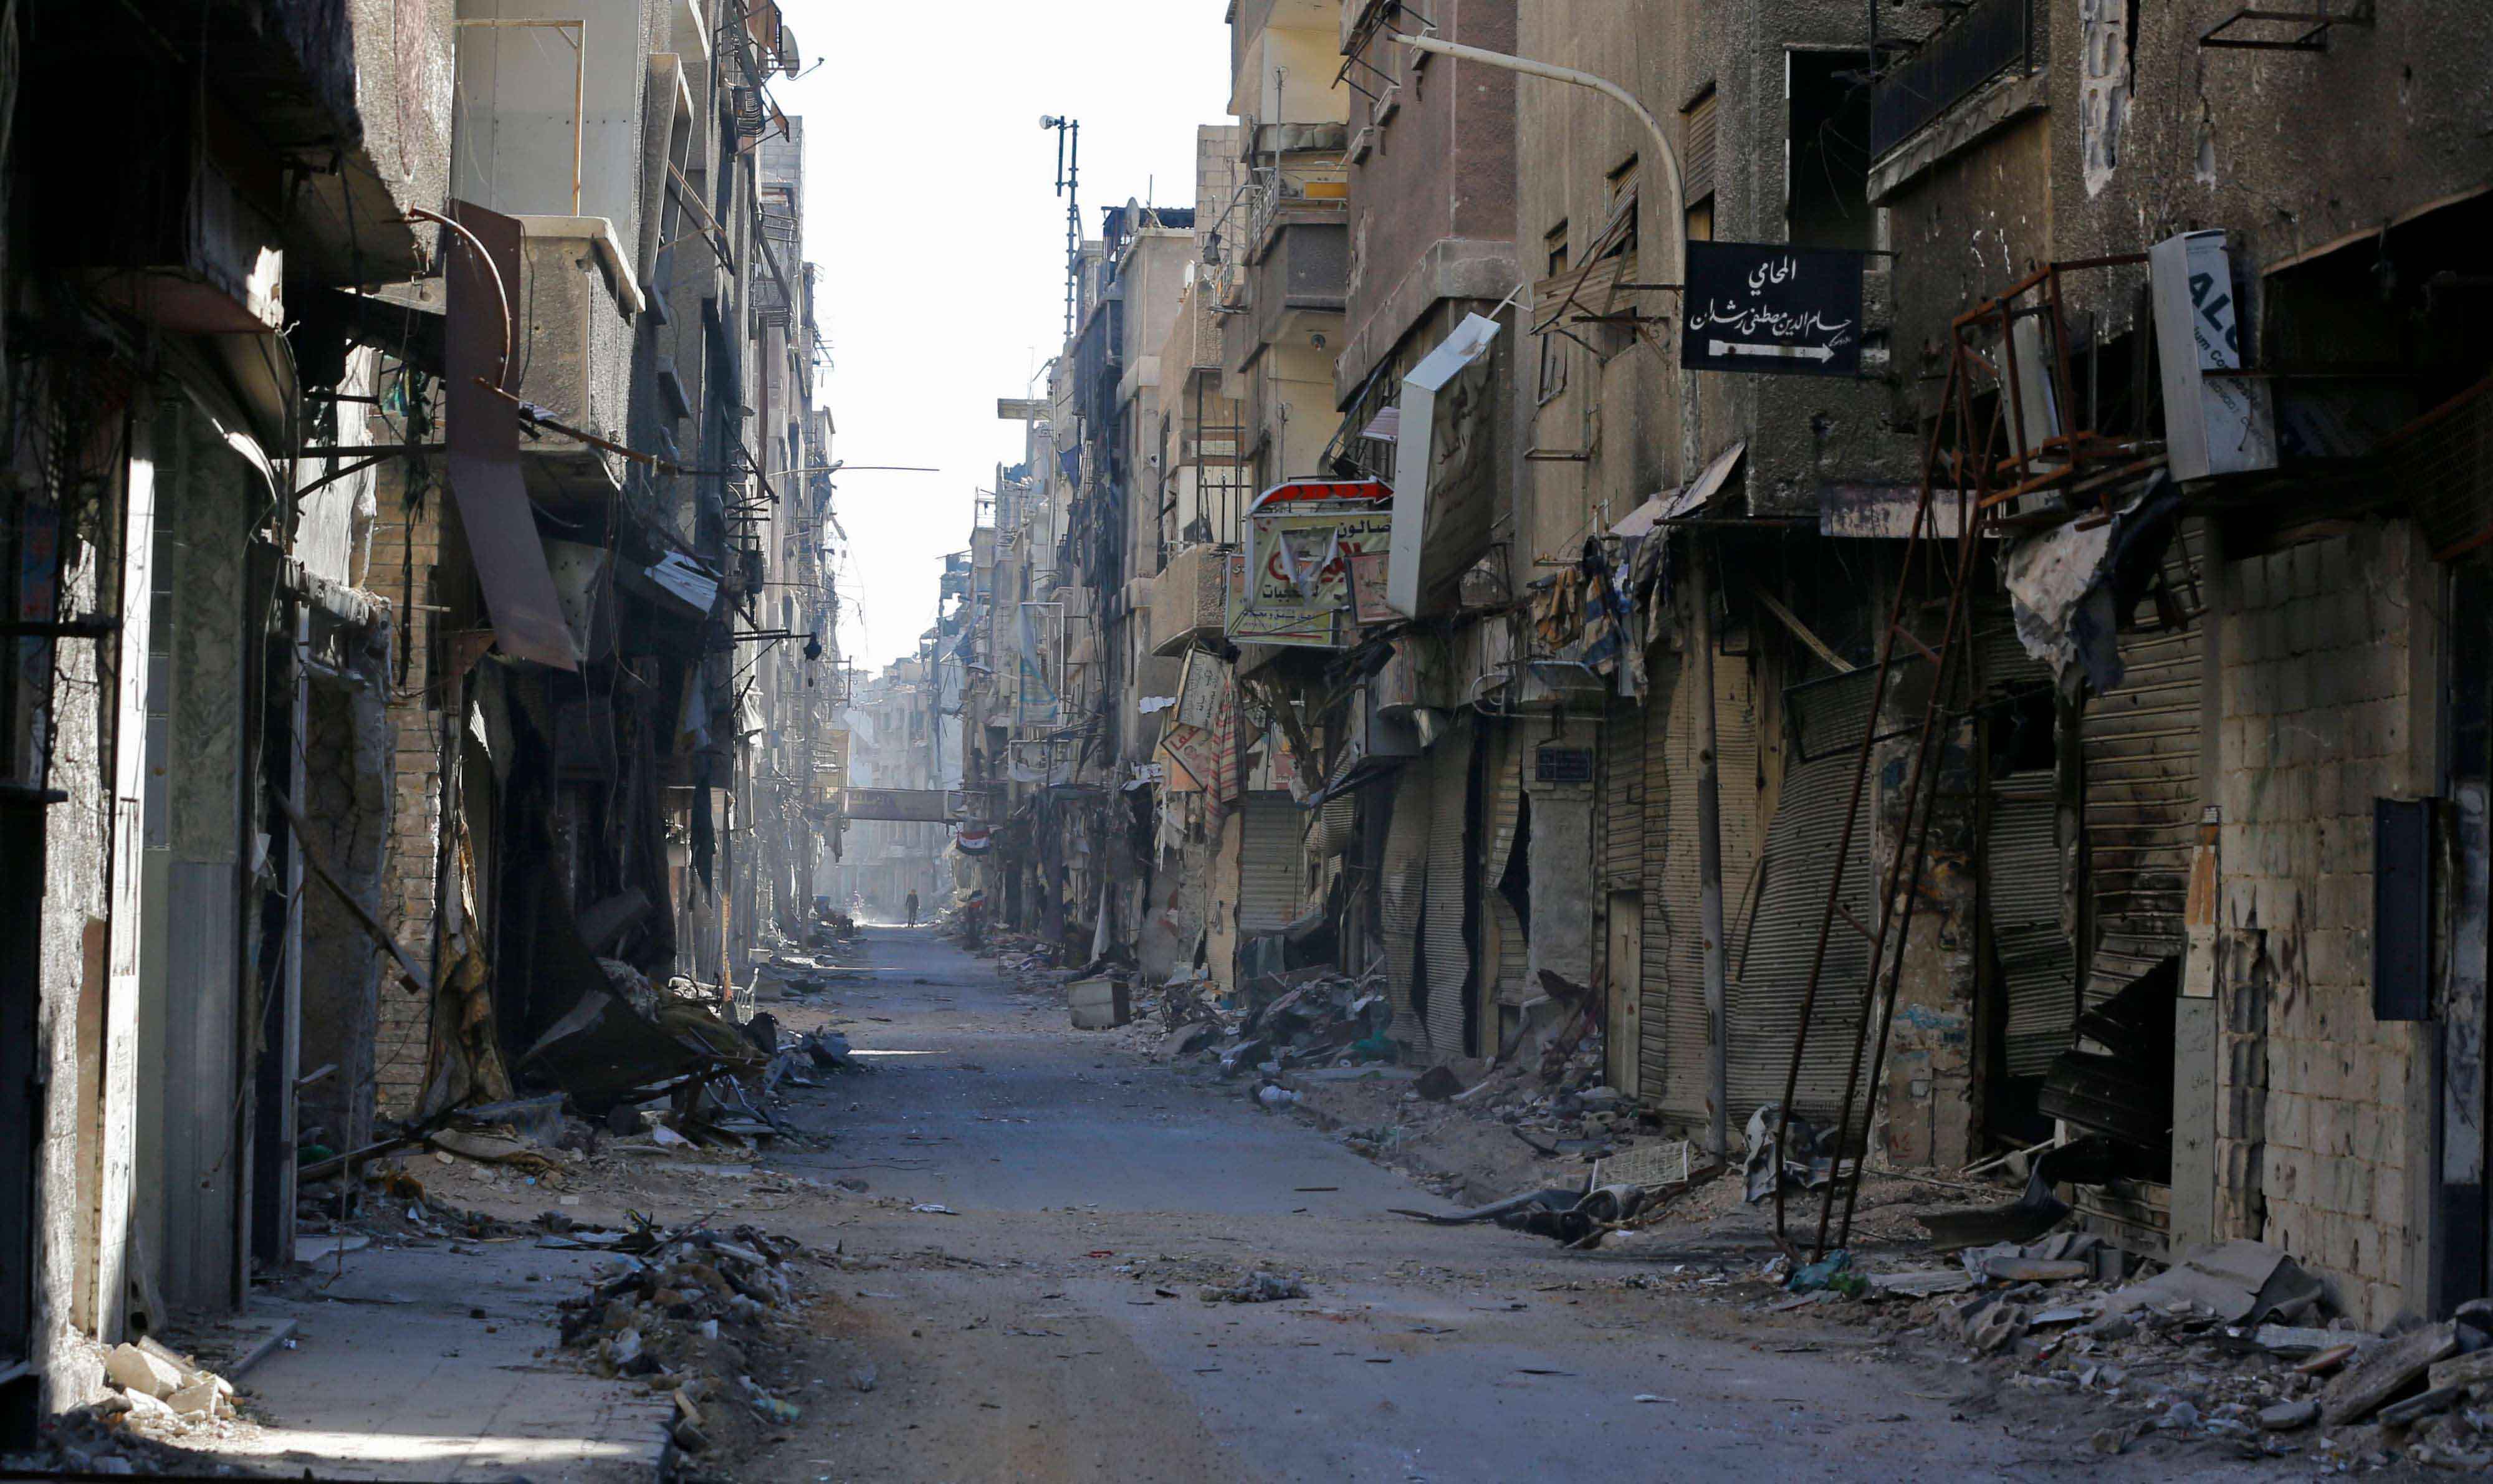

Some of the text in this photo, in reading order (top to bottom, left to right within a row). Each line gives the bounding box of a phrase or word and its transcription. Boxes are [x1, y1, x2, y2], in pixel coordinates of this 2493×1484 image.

[1748, 254, 1797, 297] المحامي
[1772, 310, 1809, 337] الدين
[1805, 310, 1852, 338] حسام
